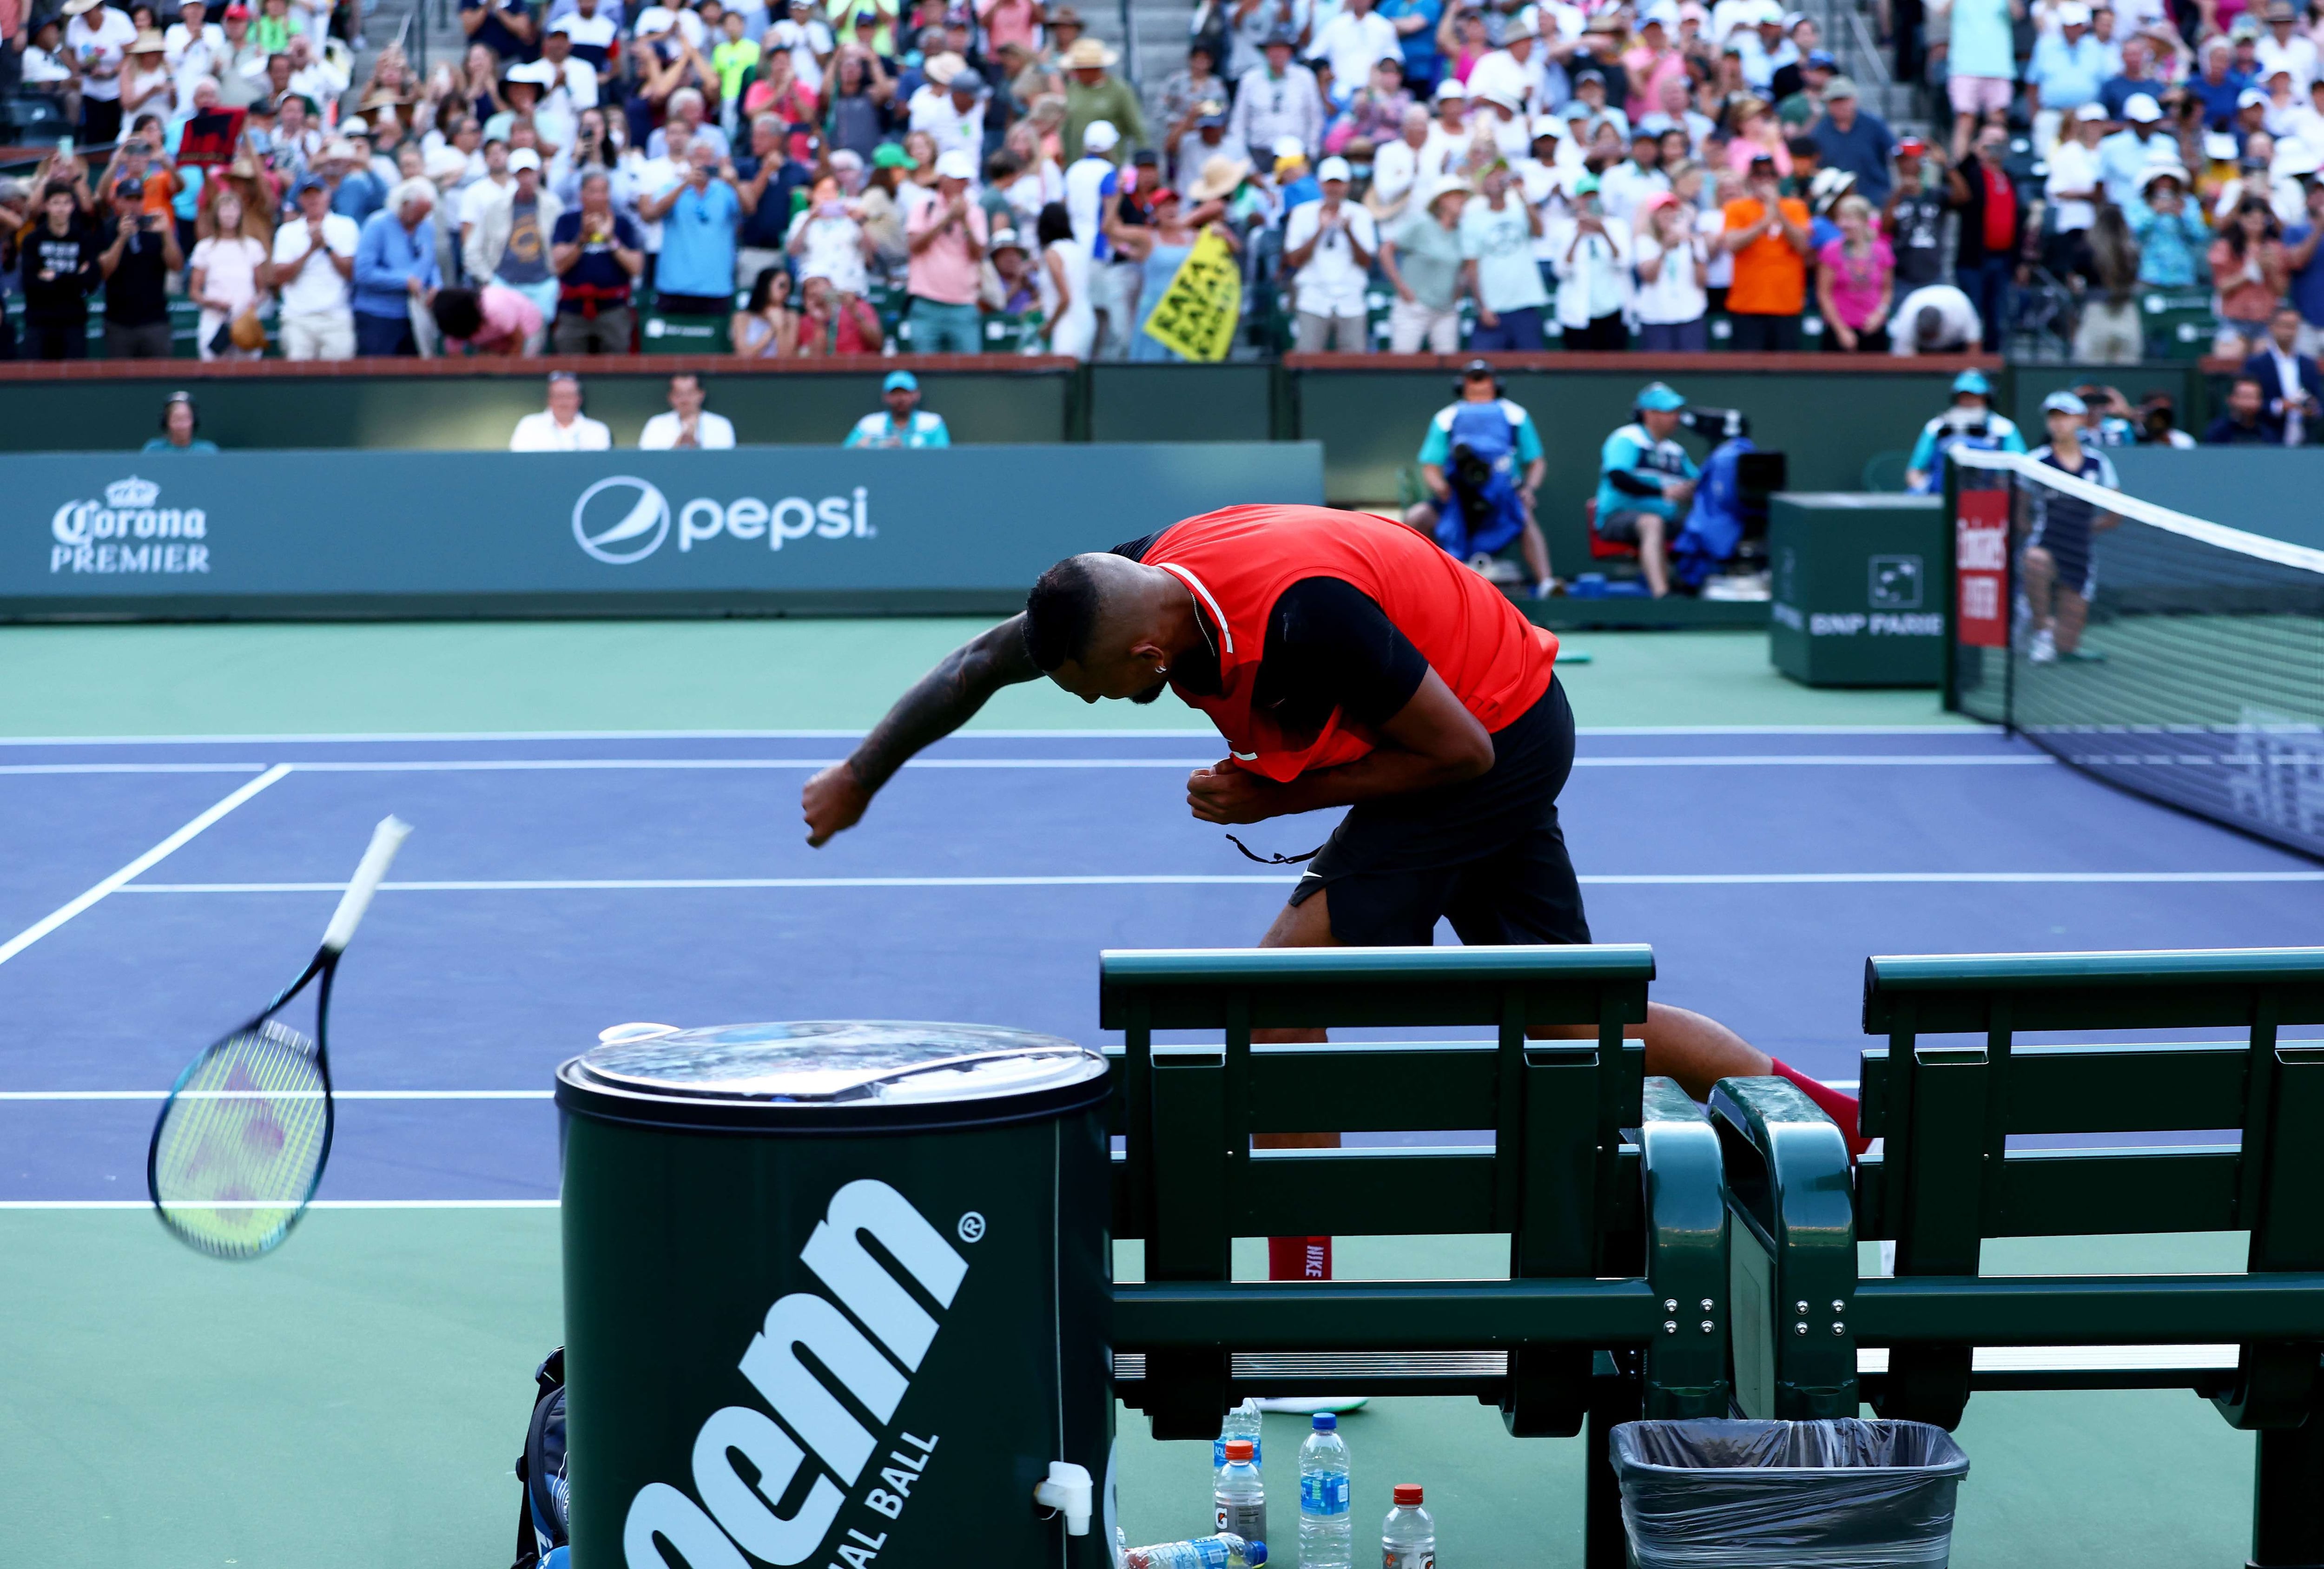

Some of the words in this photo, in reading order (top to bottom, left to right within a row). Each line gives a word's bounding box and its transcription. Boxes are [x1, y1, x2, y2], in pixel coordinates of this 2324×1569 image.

[52, 499, 207, 547] Corona
[678, 486, 868, 552] pepsi
[50, 543, 211, 574] PREMIER
[1810, 613, 1867, 636] BNP
[1306, 1245, 1324, 1278] NIKE
[1215, 1446, 1226, 1457] AQU
[827, 1528, 888, 1569] AL
[864, 1431, 940, 1520] BALL
